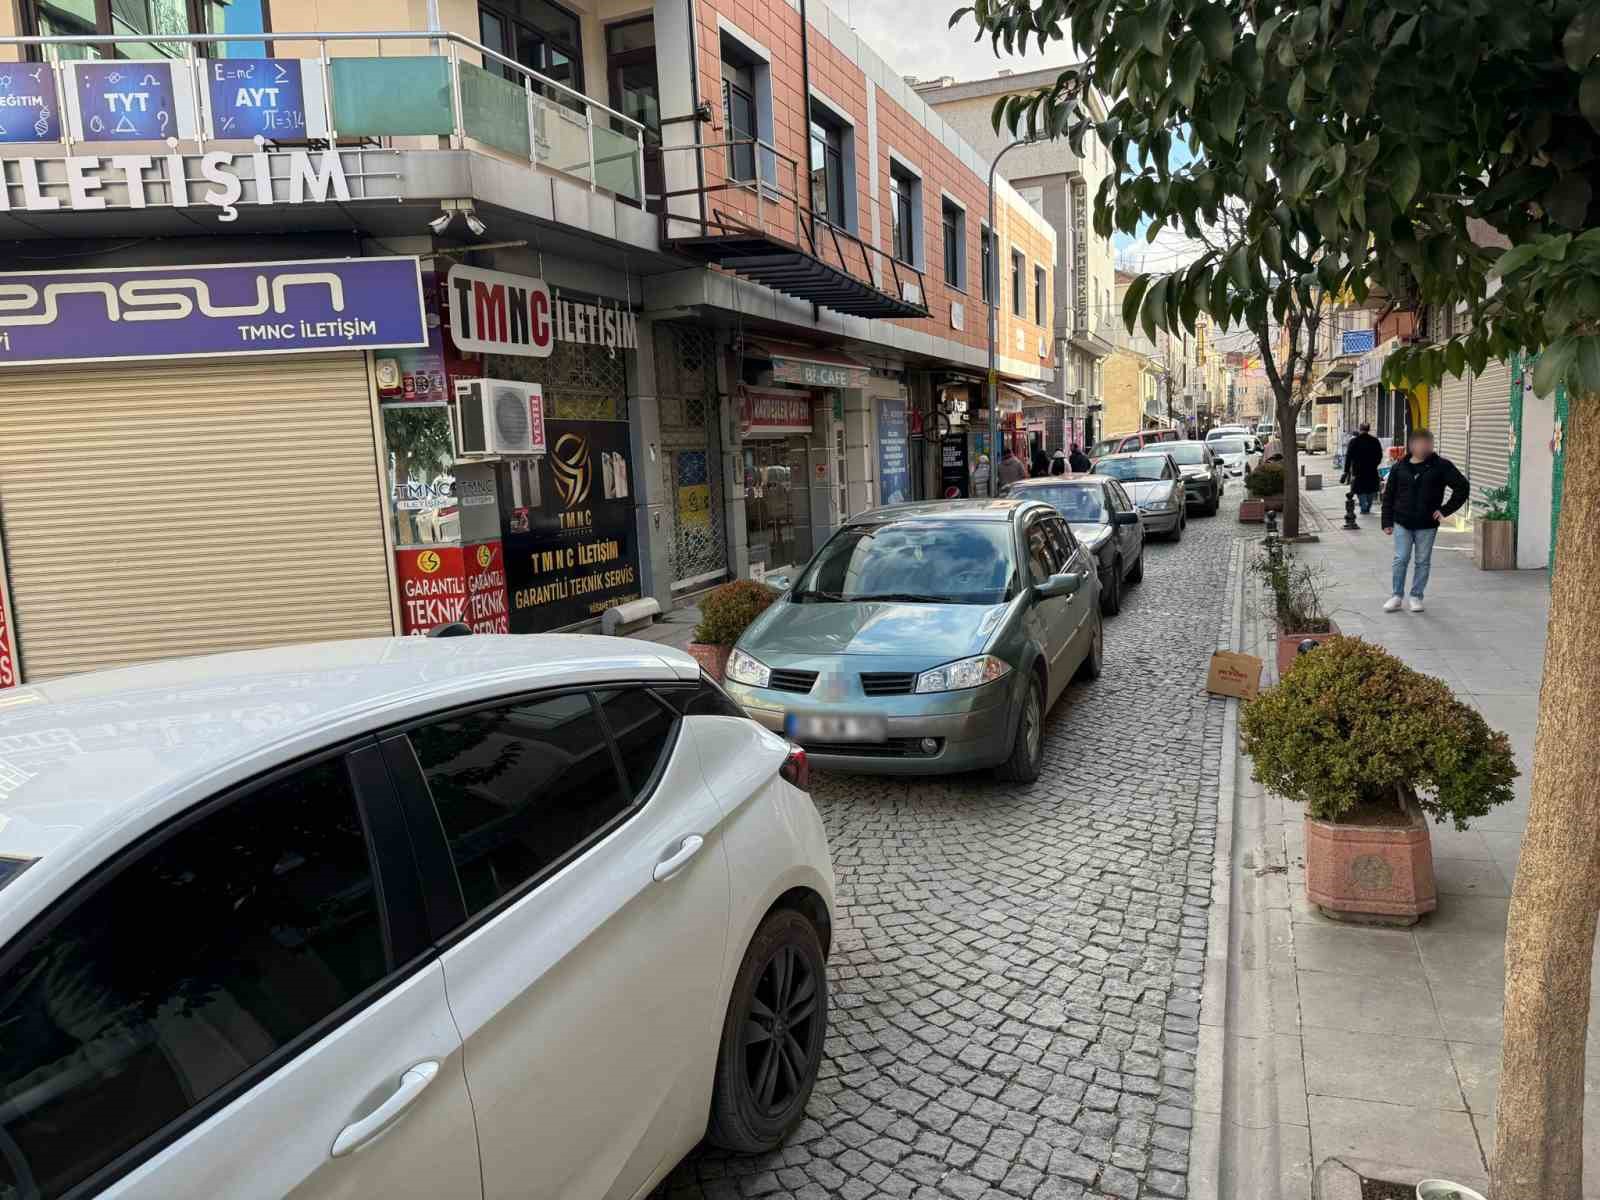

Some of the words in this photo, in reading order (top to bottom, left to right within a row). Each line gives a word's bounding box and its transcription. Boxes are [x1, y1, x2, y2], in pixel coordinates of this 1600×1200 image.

[103, 92, 149, 112] TYT
[235, 87, 280, 107] AYT
[238, 323, 295, 342] TMNC
[300, 316, 377, 341] İLETİŞİM
[453, 277, 550, 347] TMNC
[555, 287, 639, 359] İLETİŞİM
[604, 563, 634, 588] SERVİS
